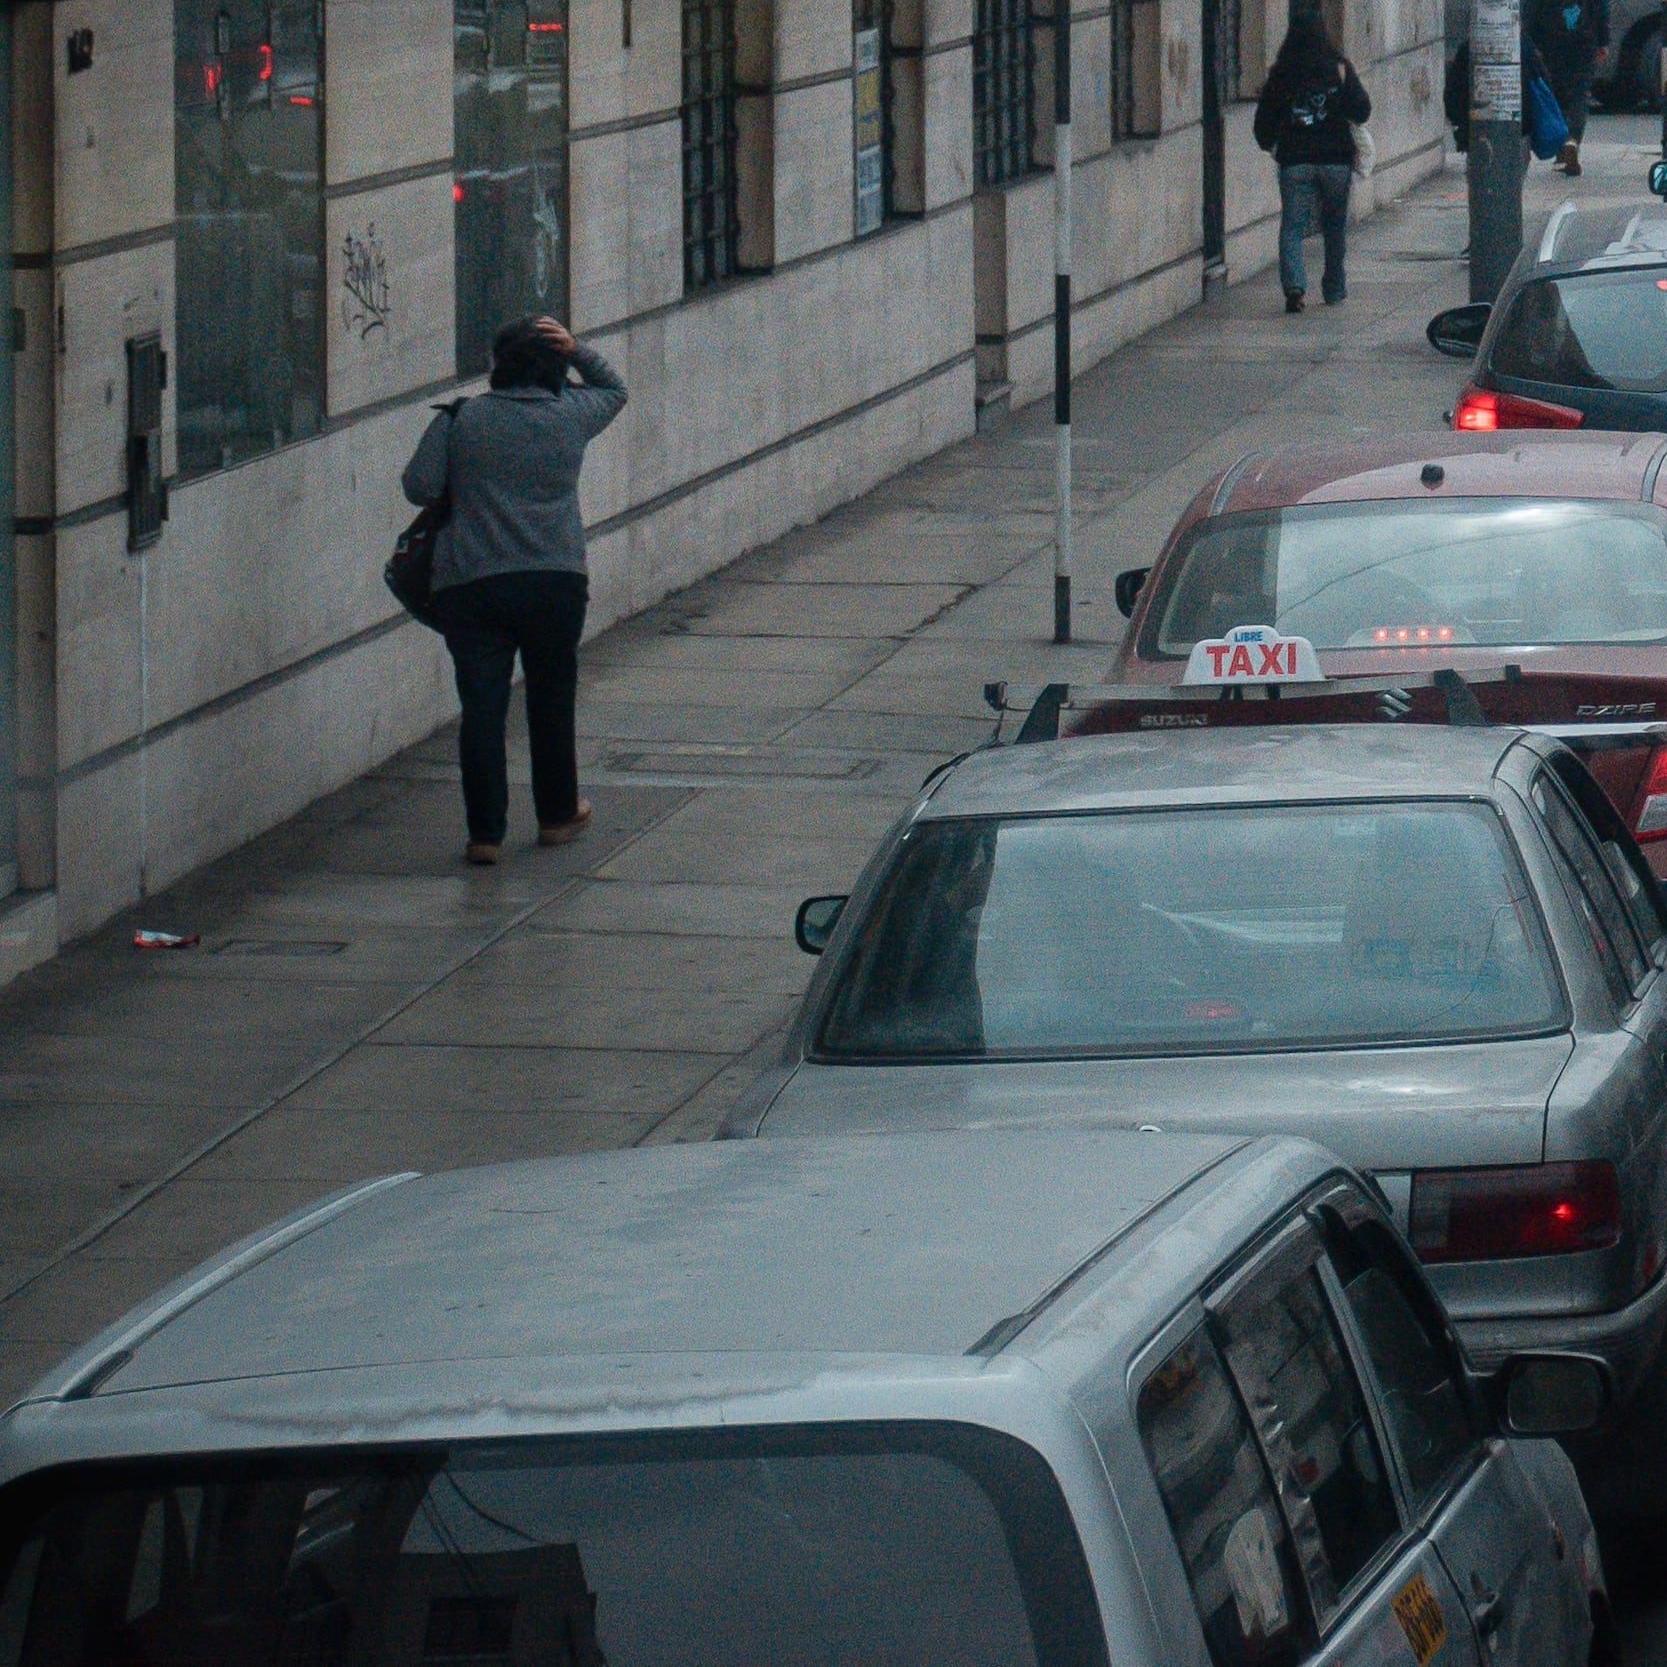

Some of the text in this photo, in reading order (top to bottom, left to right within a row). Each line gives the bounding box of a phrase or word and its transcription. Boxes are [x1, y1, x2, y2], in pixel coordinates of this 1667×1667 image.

[1234, 631, 1264, 643] LIBRE
[1206, 643, 1297, 677] TAXI
[1140, 713, 1208, 728] SUZUKI
